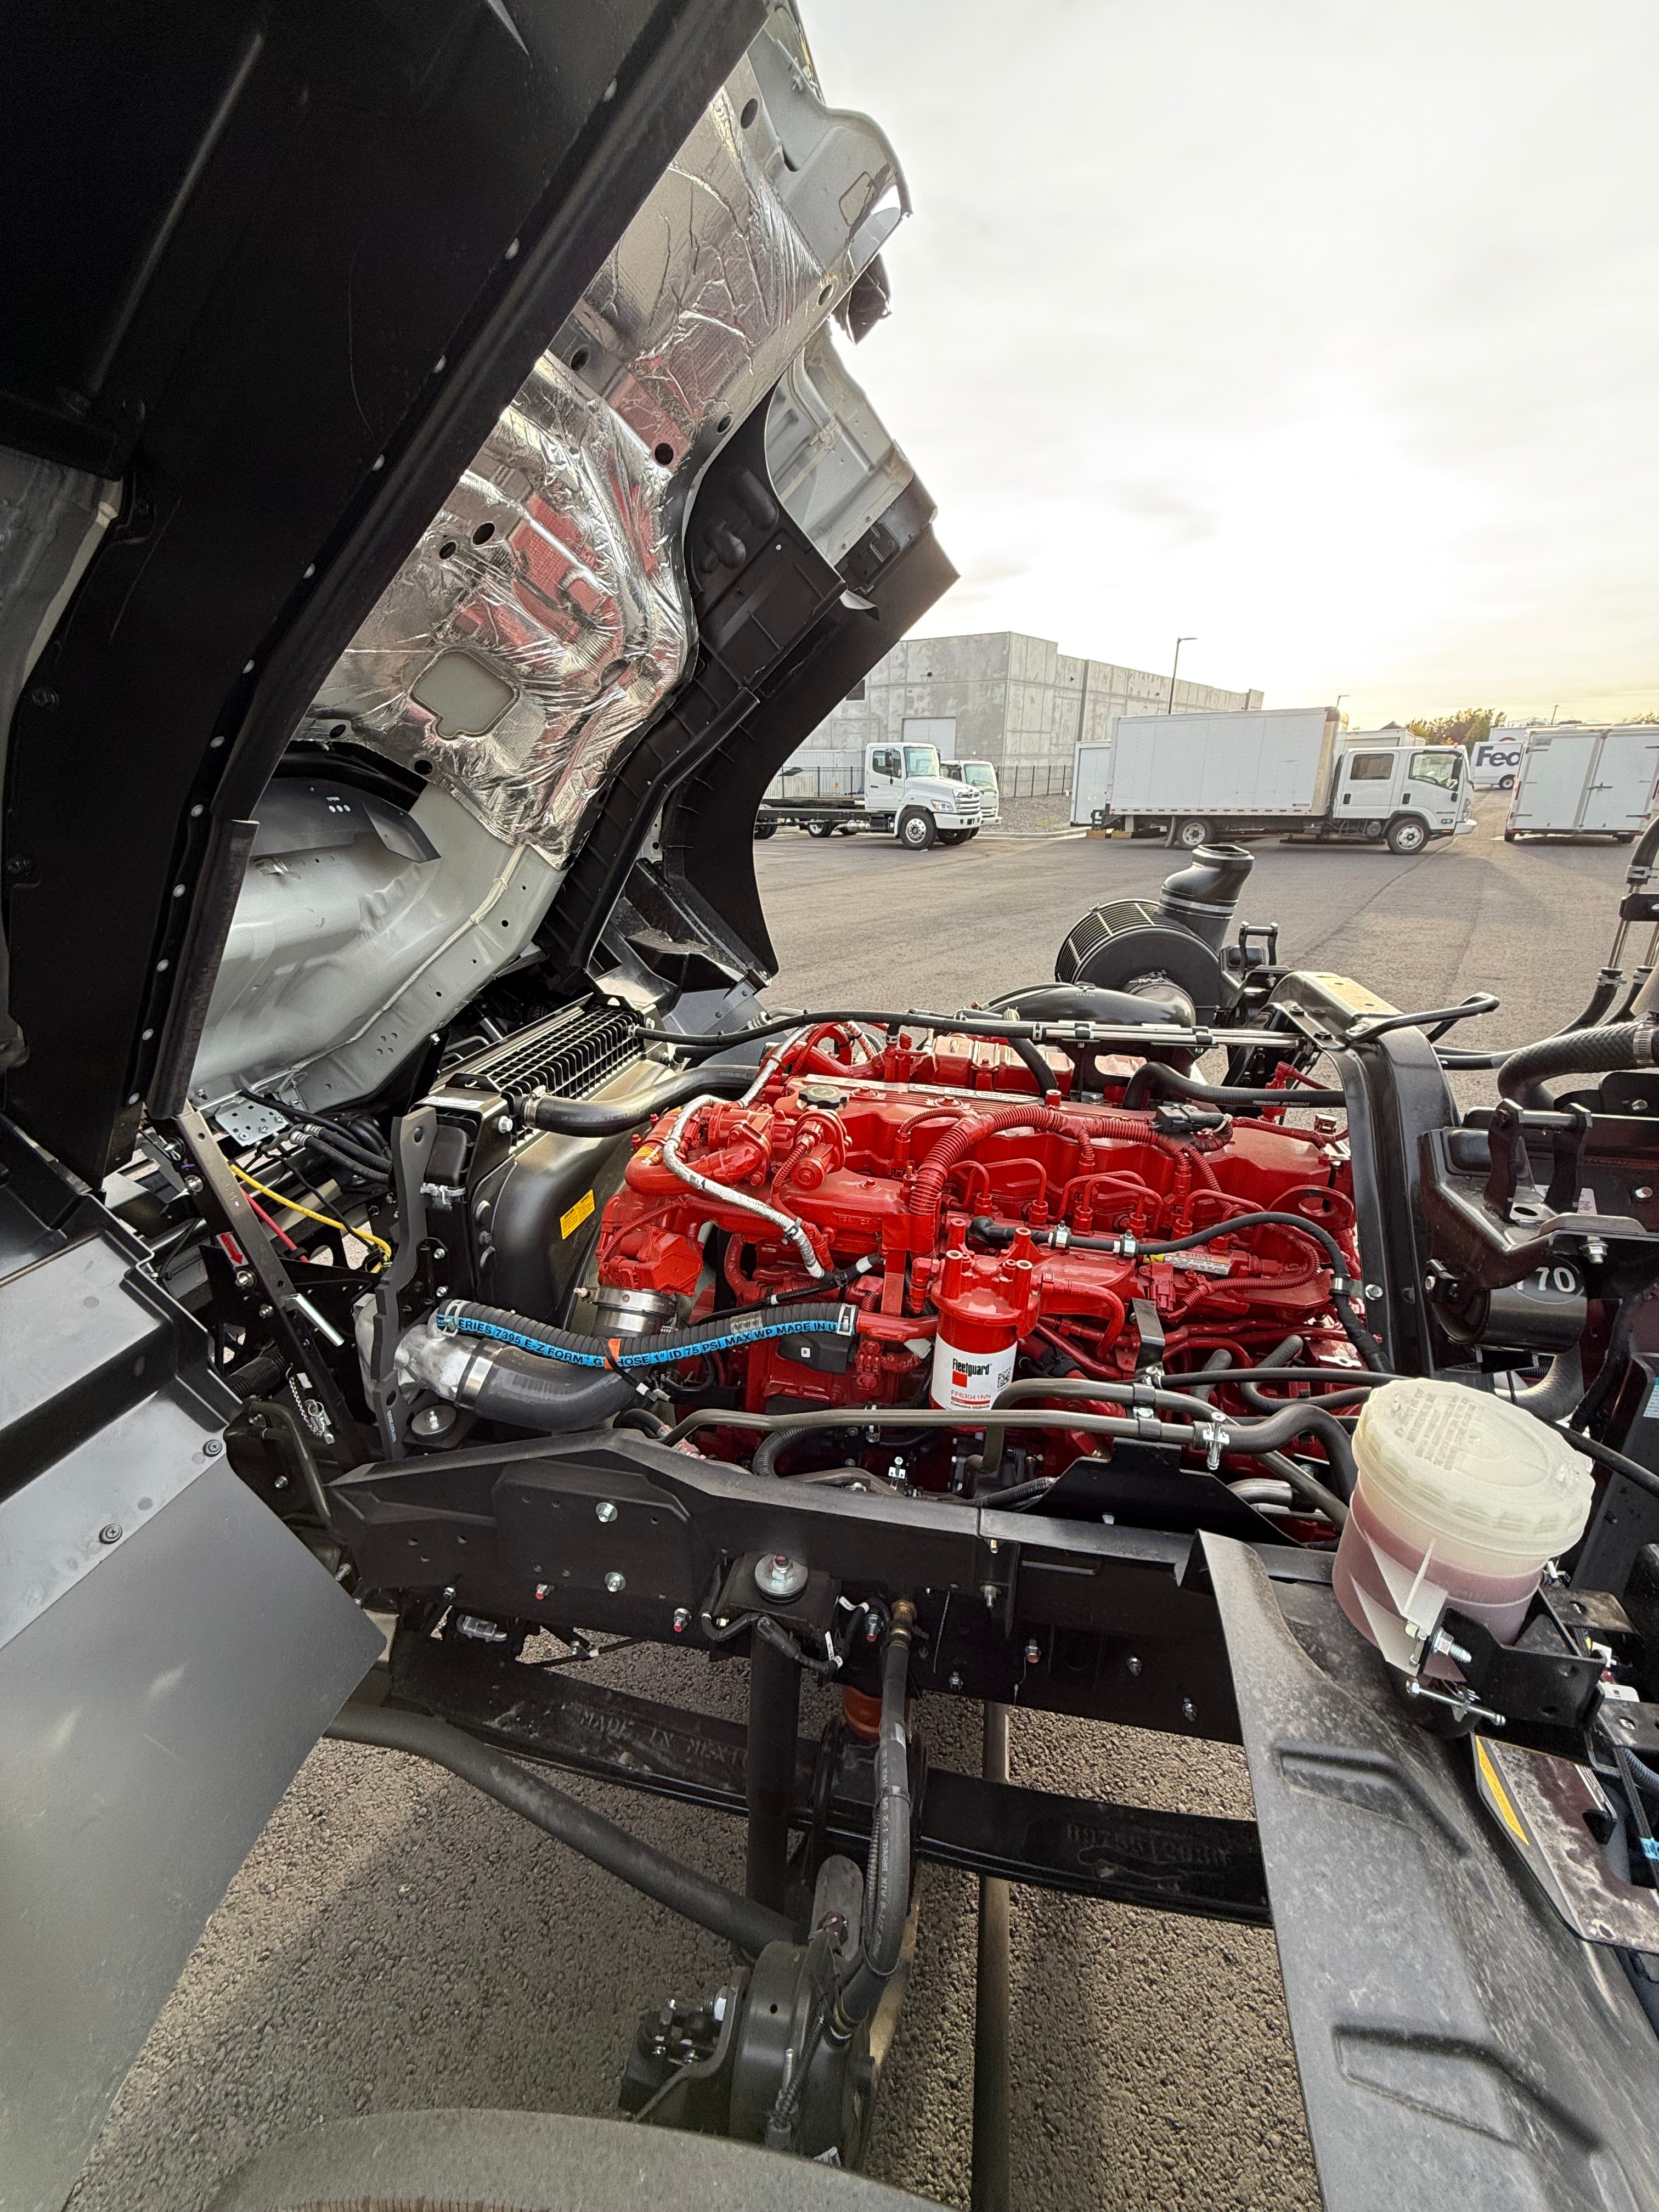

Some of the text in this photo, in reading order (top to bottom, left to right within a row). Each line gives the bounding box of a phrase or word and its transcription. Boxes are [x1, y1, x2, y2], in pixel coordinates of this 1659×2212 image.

[1516, 1267, 1576, 1293] 70
[459, 1318, 492, 1334] ERIES
[495, 1329, 521, 1345] 7395
[524, 1339, 545, 1352] E-Z
[618, 1355, 651, 1365] HOSE
[669, 1350, 682, 1359] ID
[685, 1346, 699, 1356] 75
[702, 1340, 722, 1353] PSI
[724, 1333, 752, 1346] MAX
[754, 1328, 773, 1339] WP
[776, 1322, 810, 1335] MADE
[814, 1322, 825, 1330] IN
[952, 1358, 990, 1377] Fleetguard
[951, 1389, 991, 1400] FF63041NN
[880, 1838, 889, 1872] BRAKE
